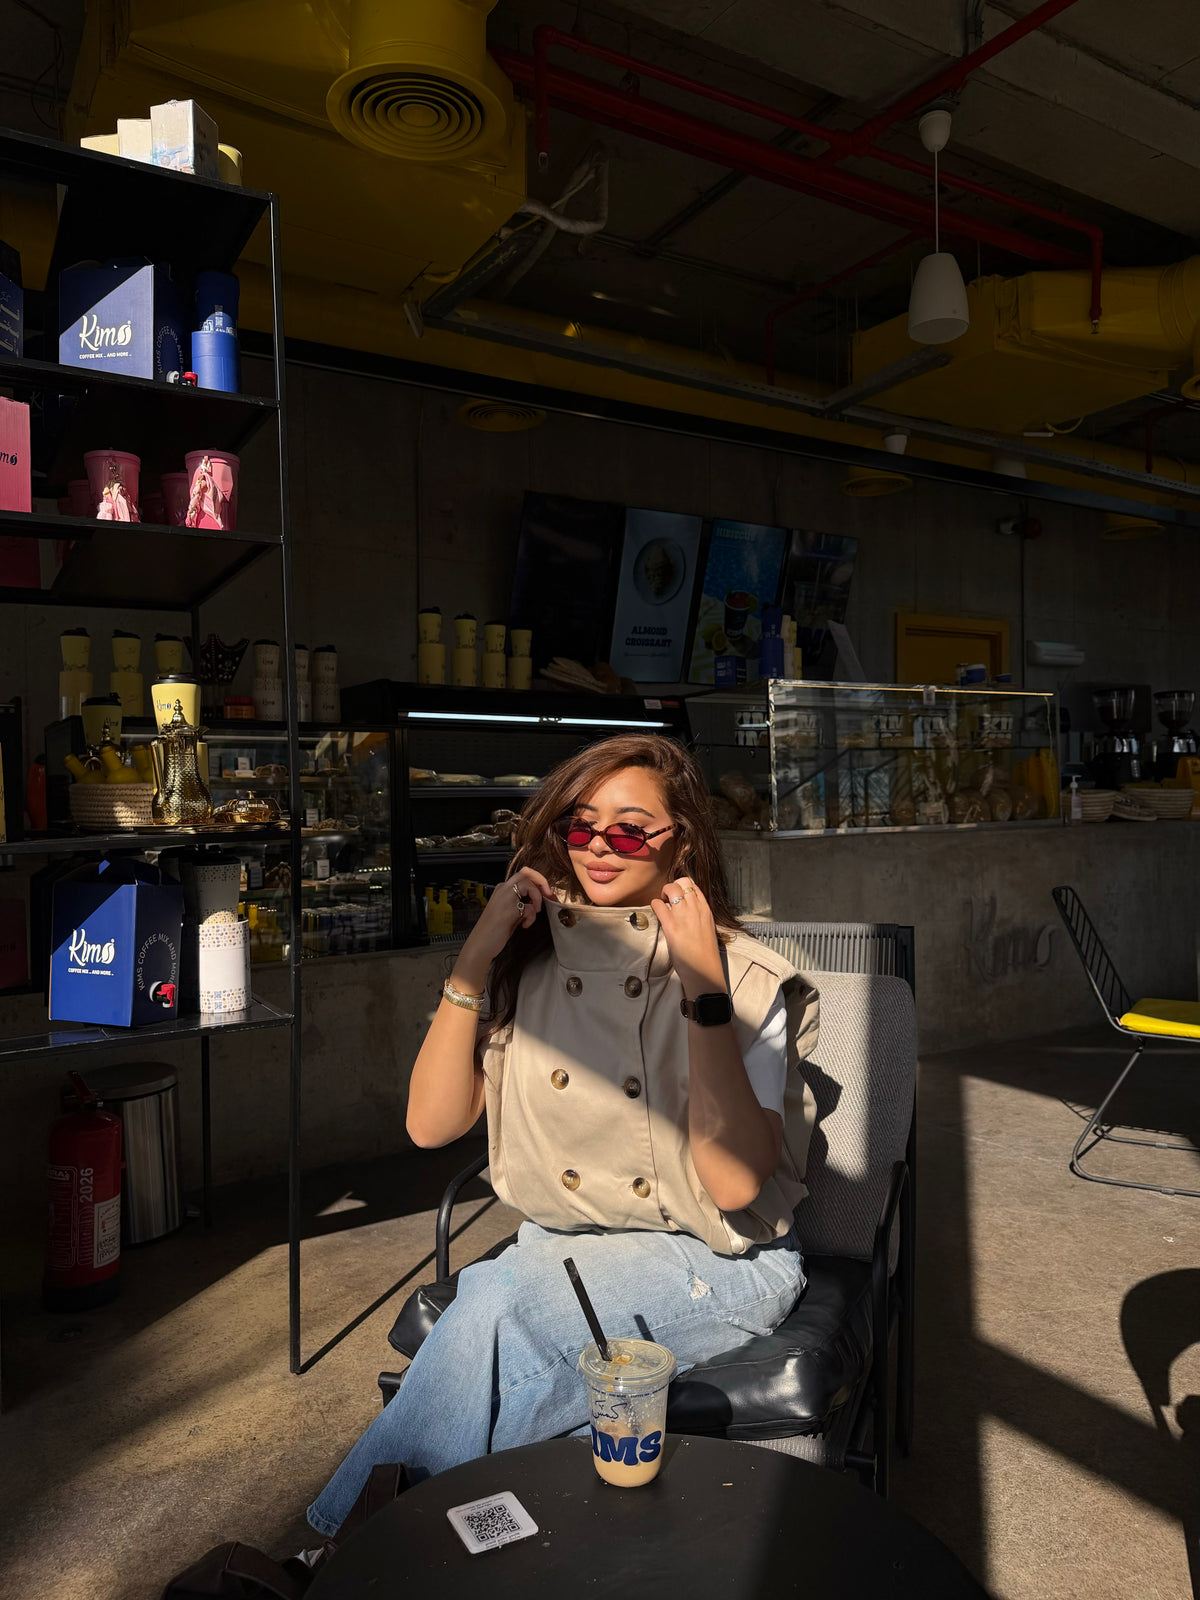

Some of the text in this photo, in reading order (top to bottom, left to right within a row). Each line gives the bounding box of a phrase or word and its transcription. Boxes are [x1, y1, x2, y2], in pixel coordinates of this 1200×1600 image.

[138, 933, 158, 965] COFFEE
[167, 942, 177, 961] AND
[80, 1167, 94, 1204] 2026
